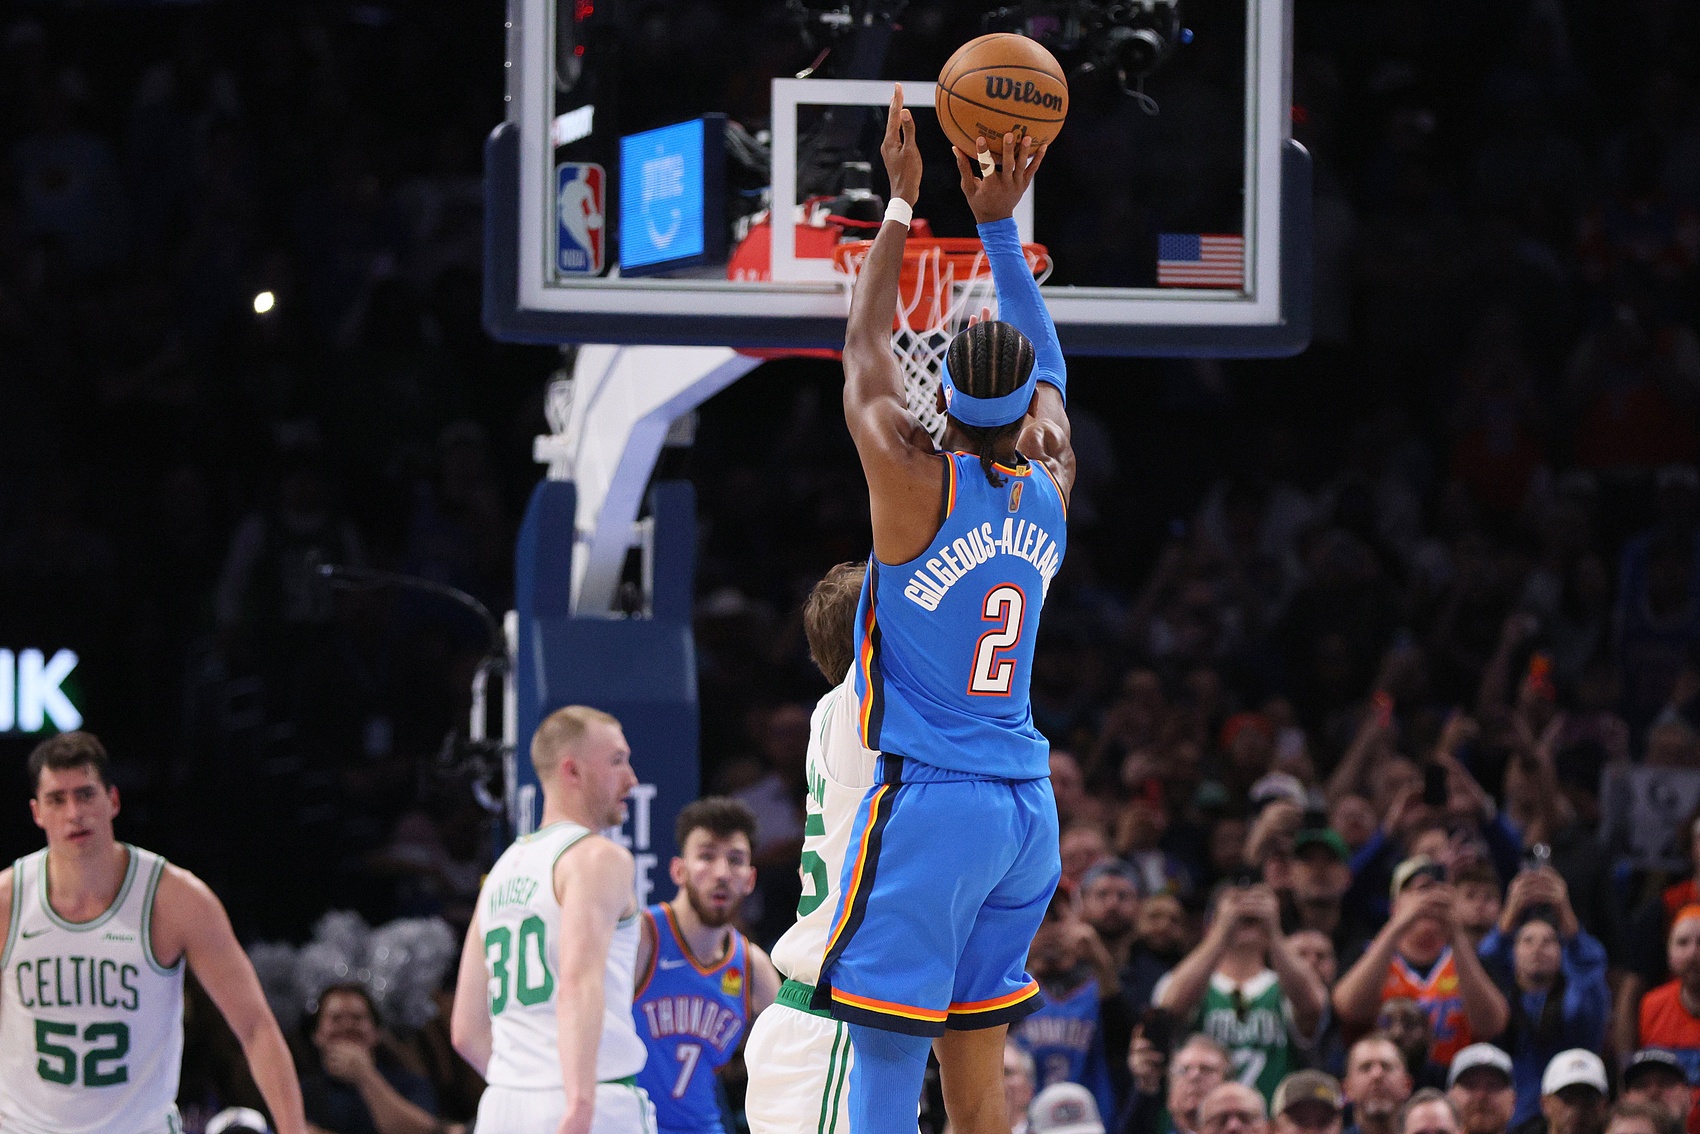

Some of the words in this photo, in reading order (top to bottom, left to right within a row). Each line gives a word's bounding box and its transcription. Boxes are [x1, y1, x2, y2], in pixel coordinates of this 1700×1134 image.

[985, 76, 1063, 112] Wilson
[967, 582, 1026, 697] 2
[17, 955, 139, 1011] CELTICS
[485, 915, 555, 1017] 30
[35, 1019, 130, 1088] 52
[671, 1042, 703, 1099] 7
